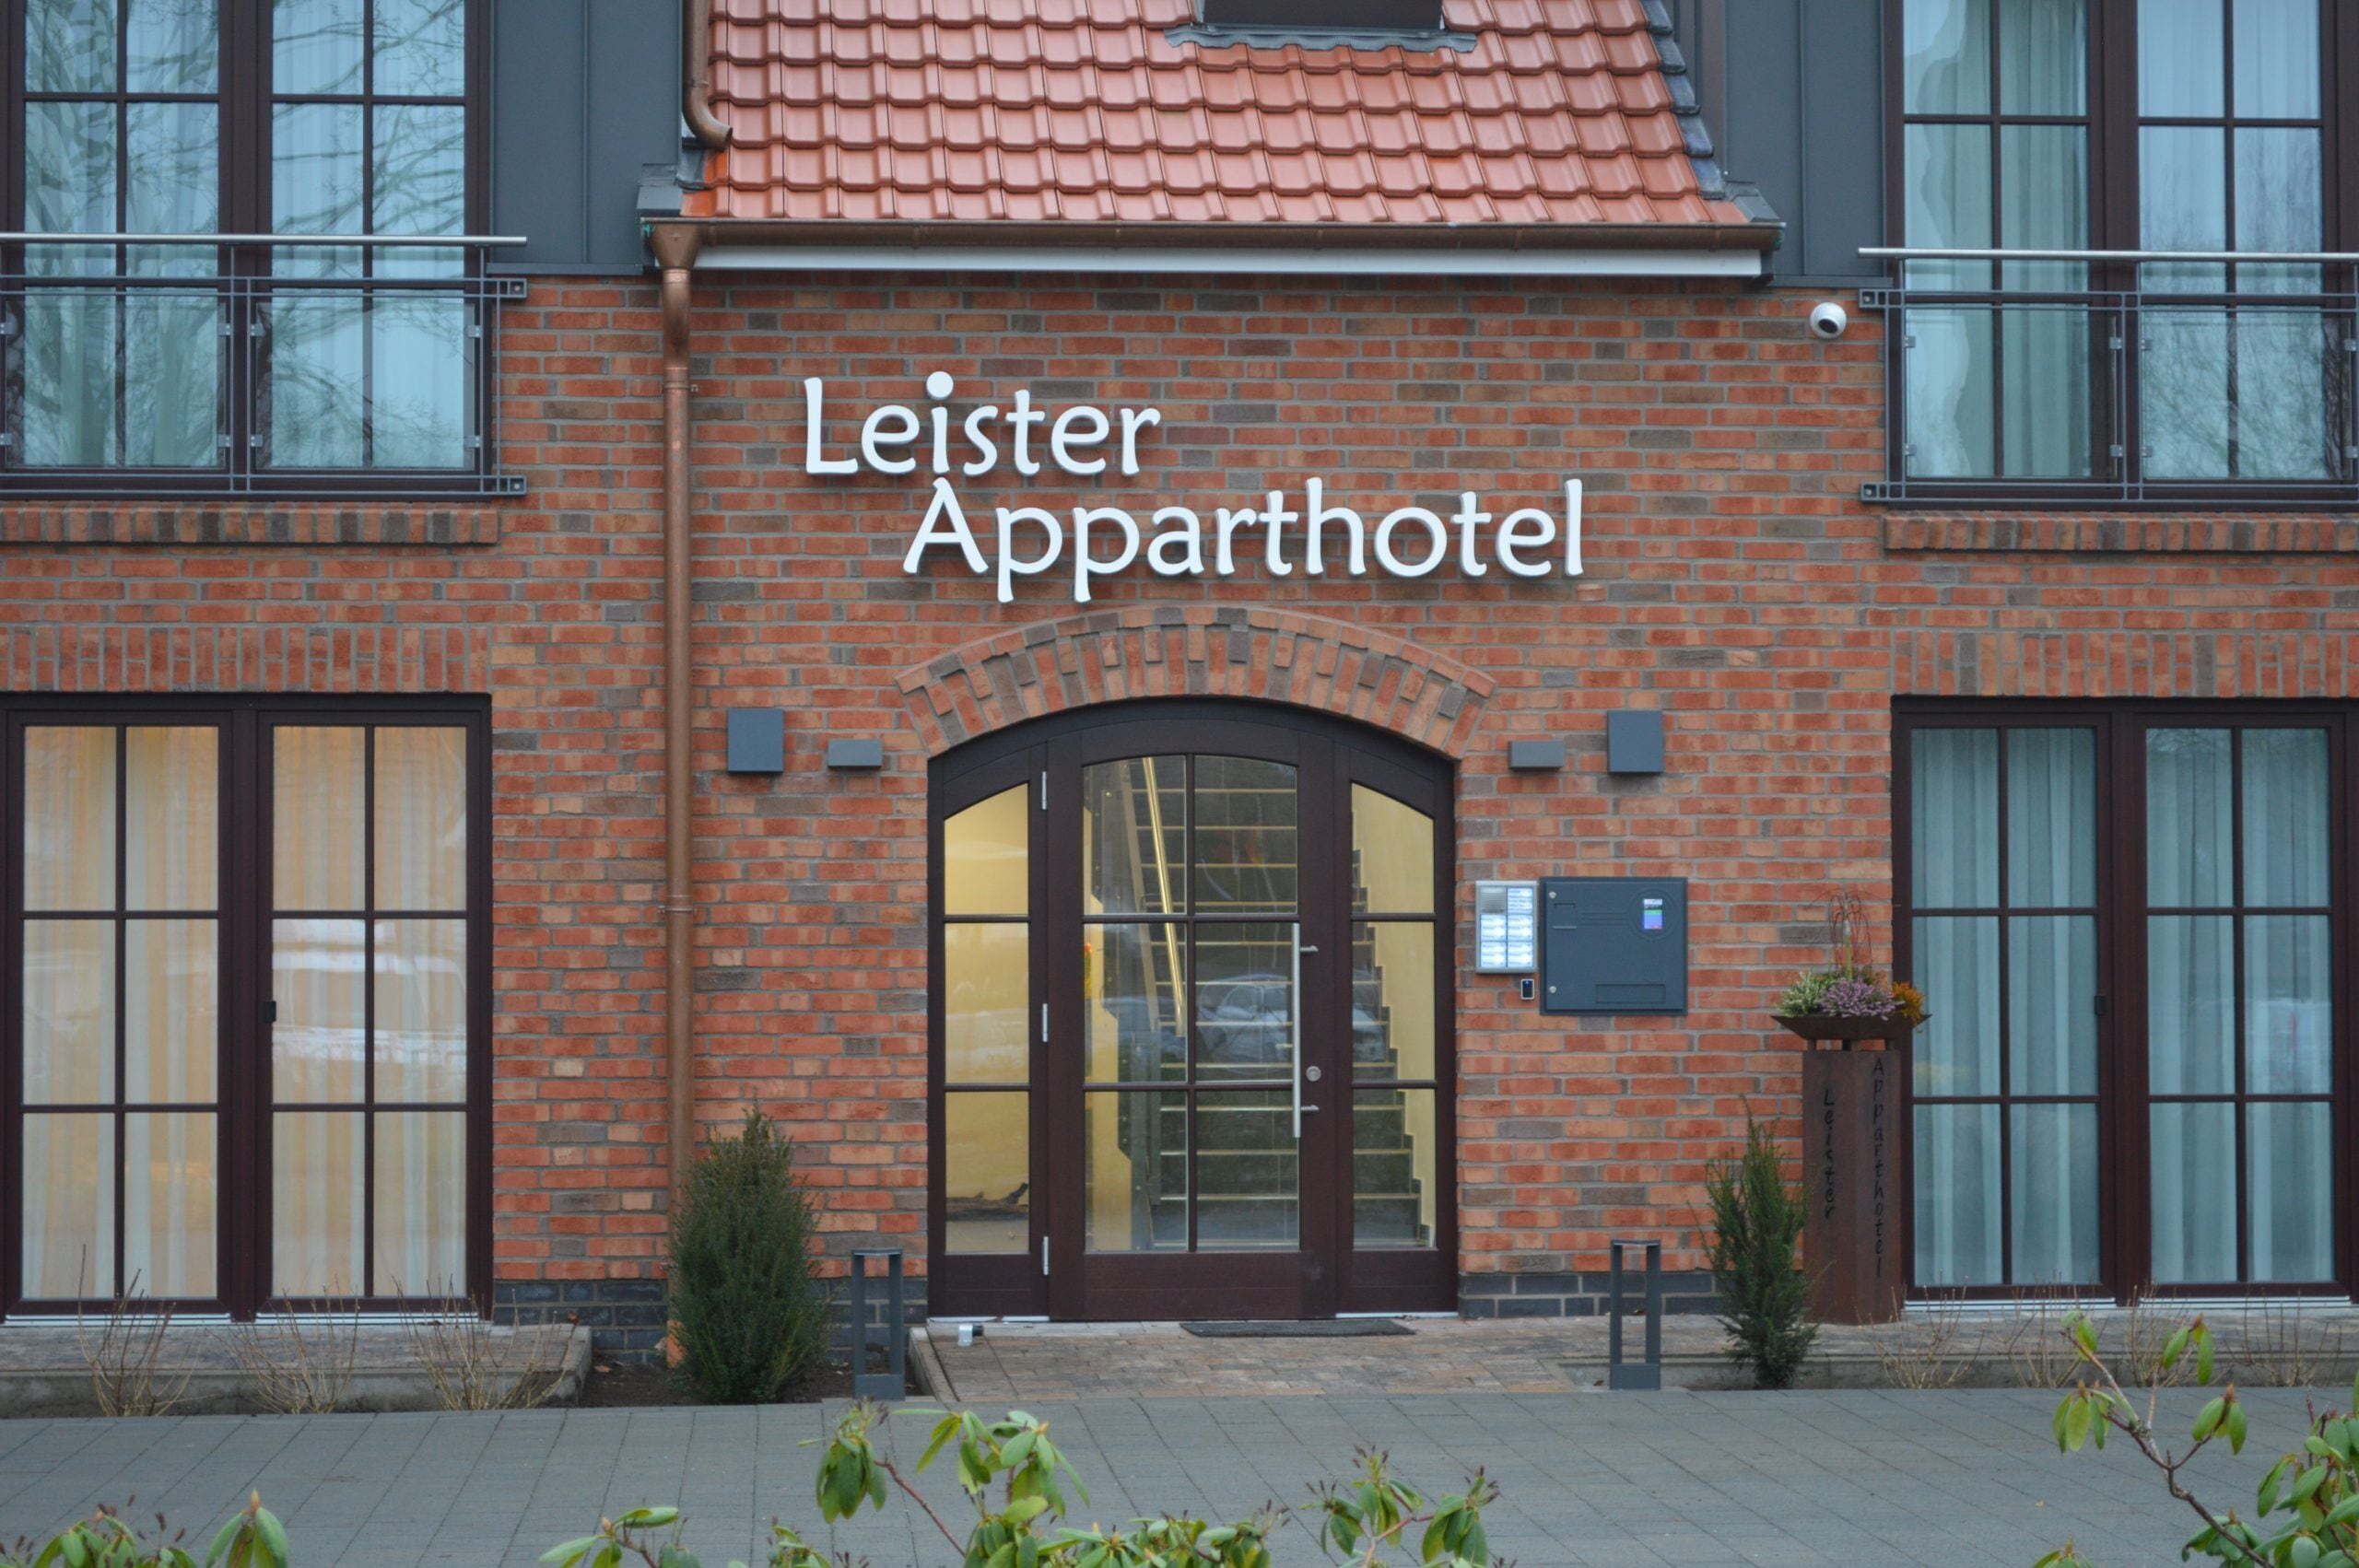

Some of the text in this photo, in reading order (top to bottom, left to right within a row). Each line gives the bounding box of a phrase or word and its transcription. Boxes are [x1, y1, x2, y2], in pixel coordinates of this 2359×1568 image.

[804, 371, 1161, 474] Leister
[904, 477, 1584, 603] Apparthotel
[1824, 1088, 1836, 1220] Leister
[1872, 1058, 1884, 1278] Apparthotel
